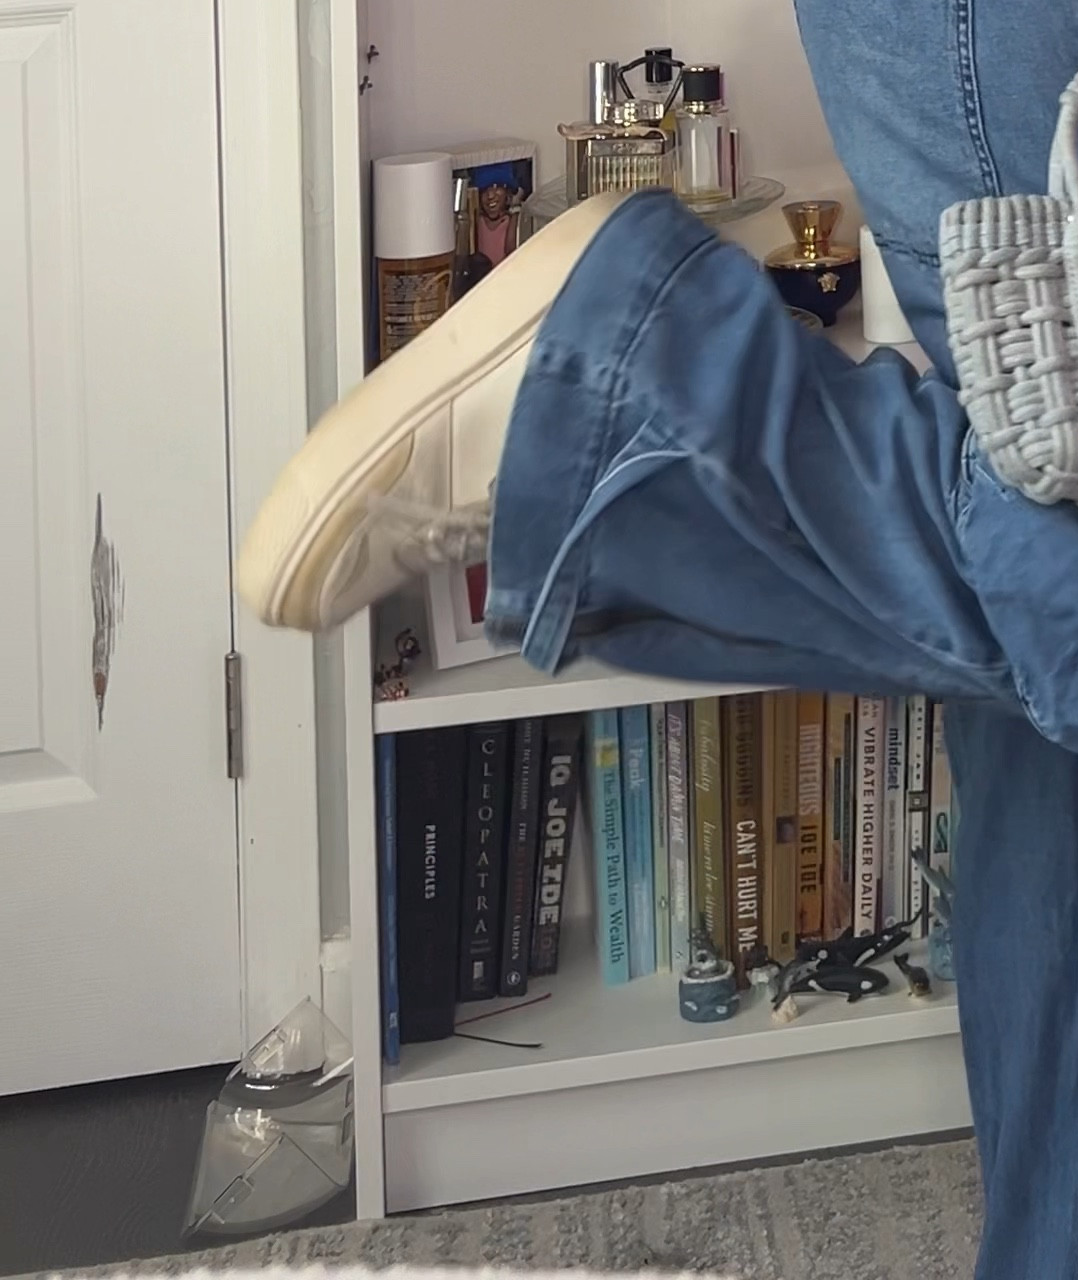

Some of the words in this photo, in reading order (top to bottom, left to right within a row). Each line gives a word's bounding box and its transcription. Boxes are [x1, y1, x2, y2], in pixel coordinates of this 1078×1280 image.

[548, 754, 572, 787] IQ
[863, 726, 876, 797] VIBRATE
[887, 727, 902, 791] mindset
[474, 738, 496, 935] CLEOPATRA
[543, 797, 567, 859] JOE
[601, 799, 620, 851] Simple
[736, 819, 758, 869] CAN'T
[861, 803, 875, 866] HIGHER
[424, 823, 437, 900] PRINCIPLES
[606, 854, 621, 889] Path
[538, 863, 563, 926] IDE
[607, 892, 617, 906] to
[737, 875, 758, 920] HURT
[860, 871, 873, 920] DAILY
[609, 910, 625, 963] Wealth
[738, 926, 758, 953] ME
